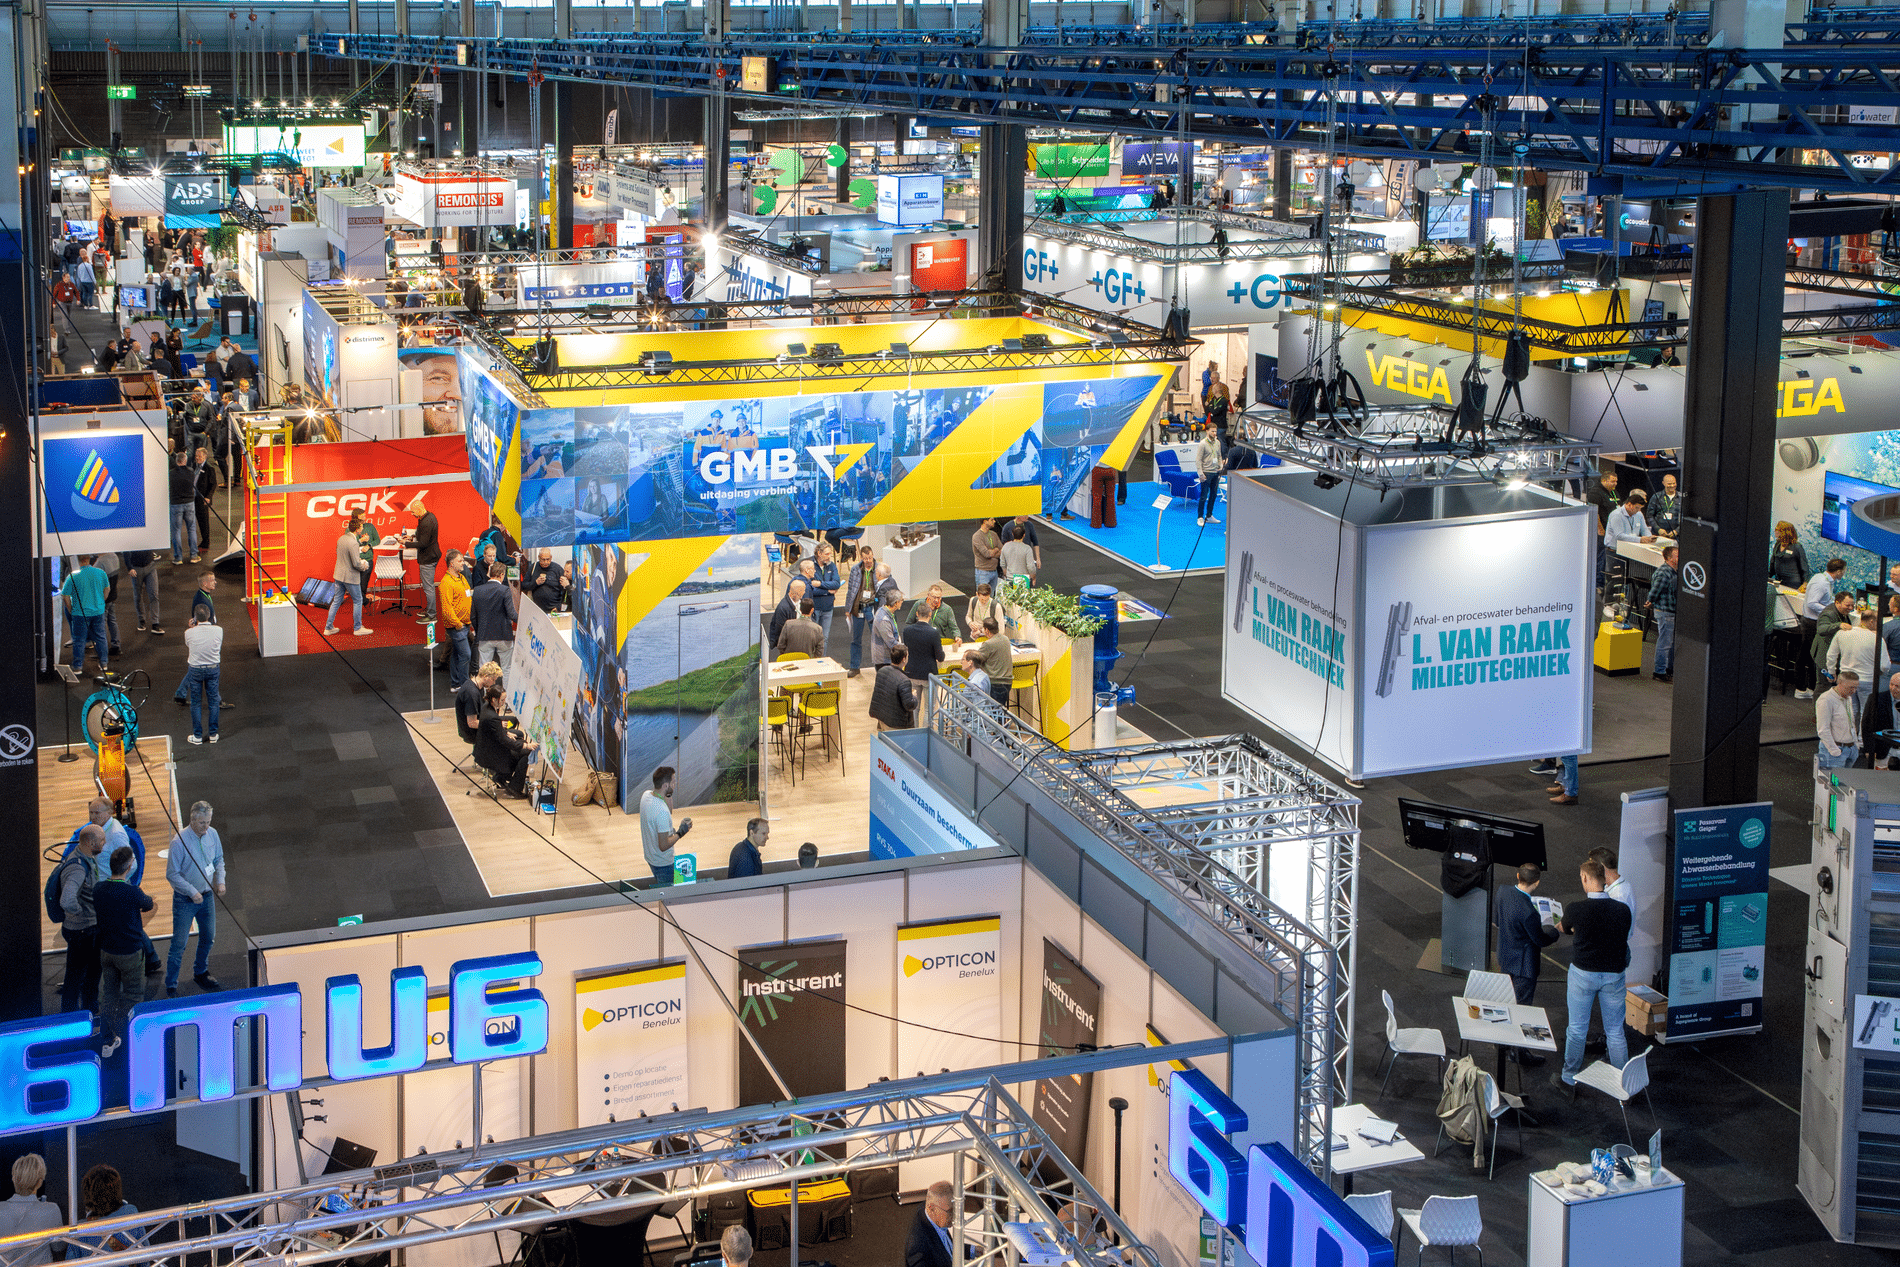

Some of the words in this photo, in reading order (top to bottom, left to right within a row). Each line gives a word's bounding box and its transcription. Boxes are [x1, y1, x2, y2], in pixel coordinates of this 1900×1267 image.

[1851, 109, 1892, 123] prowater
[1072, 156, 1107, 165] Schneider
[1138, 153, 1179, 165] AVEVA
[172, 182, 213, 199] ADS
[438, 194, 498, 207] REMONDIS
[1092, 268, 1146, 304] +GF+
[1365, 350, 1453, 405] VEGA
[1776, 377, 1846, 418] GA
[473, 412, 489, 455] GMB
[700, 448, 797, 485] GMB
[307, 491, 398, 518] CGK
[700, 487, 750, 501] uitdaging
[753, 485, 798, 497] verbindt
[341, 516, 397, 529] GOUP
[1269, 580, 1276, 589] en
[1276, 584, 1310, 607] proceswater
[1253, 586, 1264, 619] L.
[1267, 593, 1297, 638] VAN
[1301, 611, 1346, 665] RAAK
[1413, 614, 1440, 627] Afval-
[1442, 613, 1454, 623] en
[1456, 607, 1514, 625] proceswater
[1515, 601, 1574, 617] behandeling
[1252, 617, 1345, 691] MILIEUTECHNIEK
[1412, 633, 1432, 665] L.
[1438, 626, 1492, 662] VAN
[1499, 618, 1572, 655] RAAK
[1411, 652, 1571, 691] MILIEUTECHNIEK
[877, 757, 896, 783] STAKA
[901, 779, 936, 820] Duurzaam
[1682, 853, 1733, 865] Weitergehende
[1682, 861, 1756, 874] Abwasserbehandlung
[922, 951, 996, 971] OPTICON
[958, 967, 996, 980] Benelux
[743, 972, 843, 997] Instrurent
[602, 998, 682, 1024] OPTICON
[1043, 968, 1095, 1032] Instrurent
[642, 1016, 681, 1030] Benelux
[613, 1068, 632, 1080] Demo
[634, 1068, 644, 1078] op
[644, 1064, 667, 1075] locatie
[613, 1083, 632, 1094] Eigen
[633, 1074, 683, 1091] reparatiedienst
[613, 1095, 633, 1106] Breed
[634, 1089, 675, 1102] assortiment
